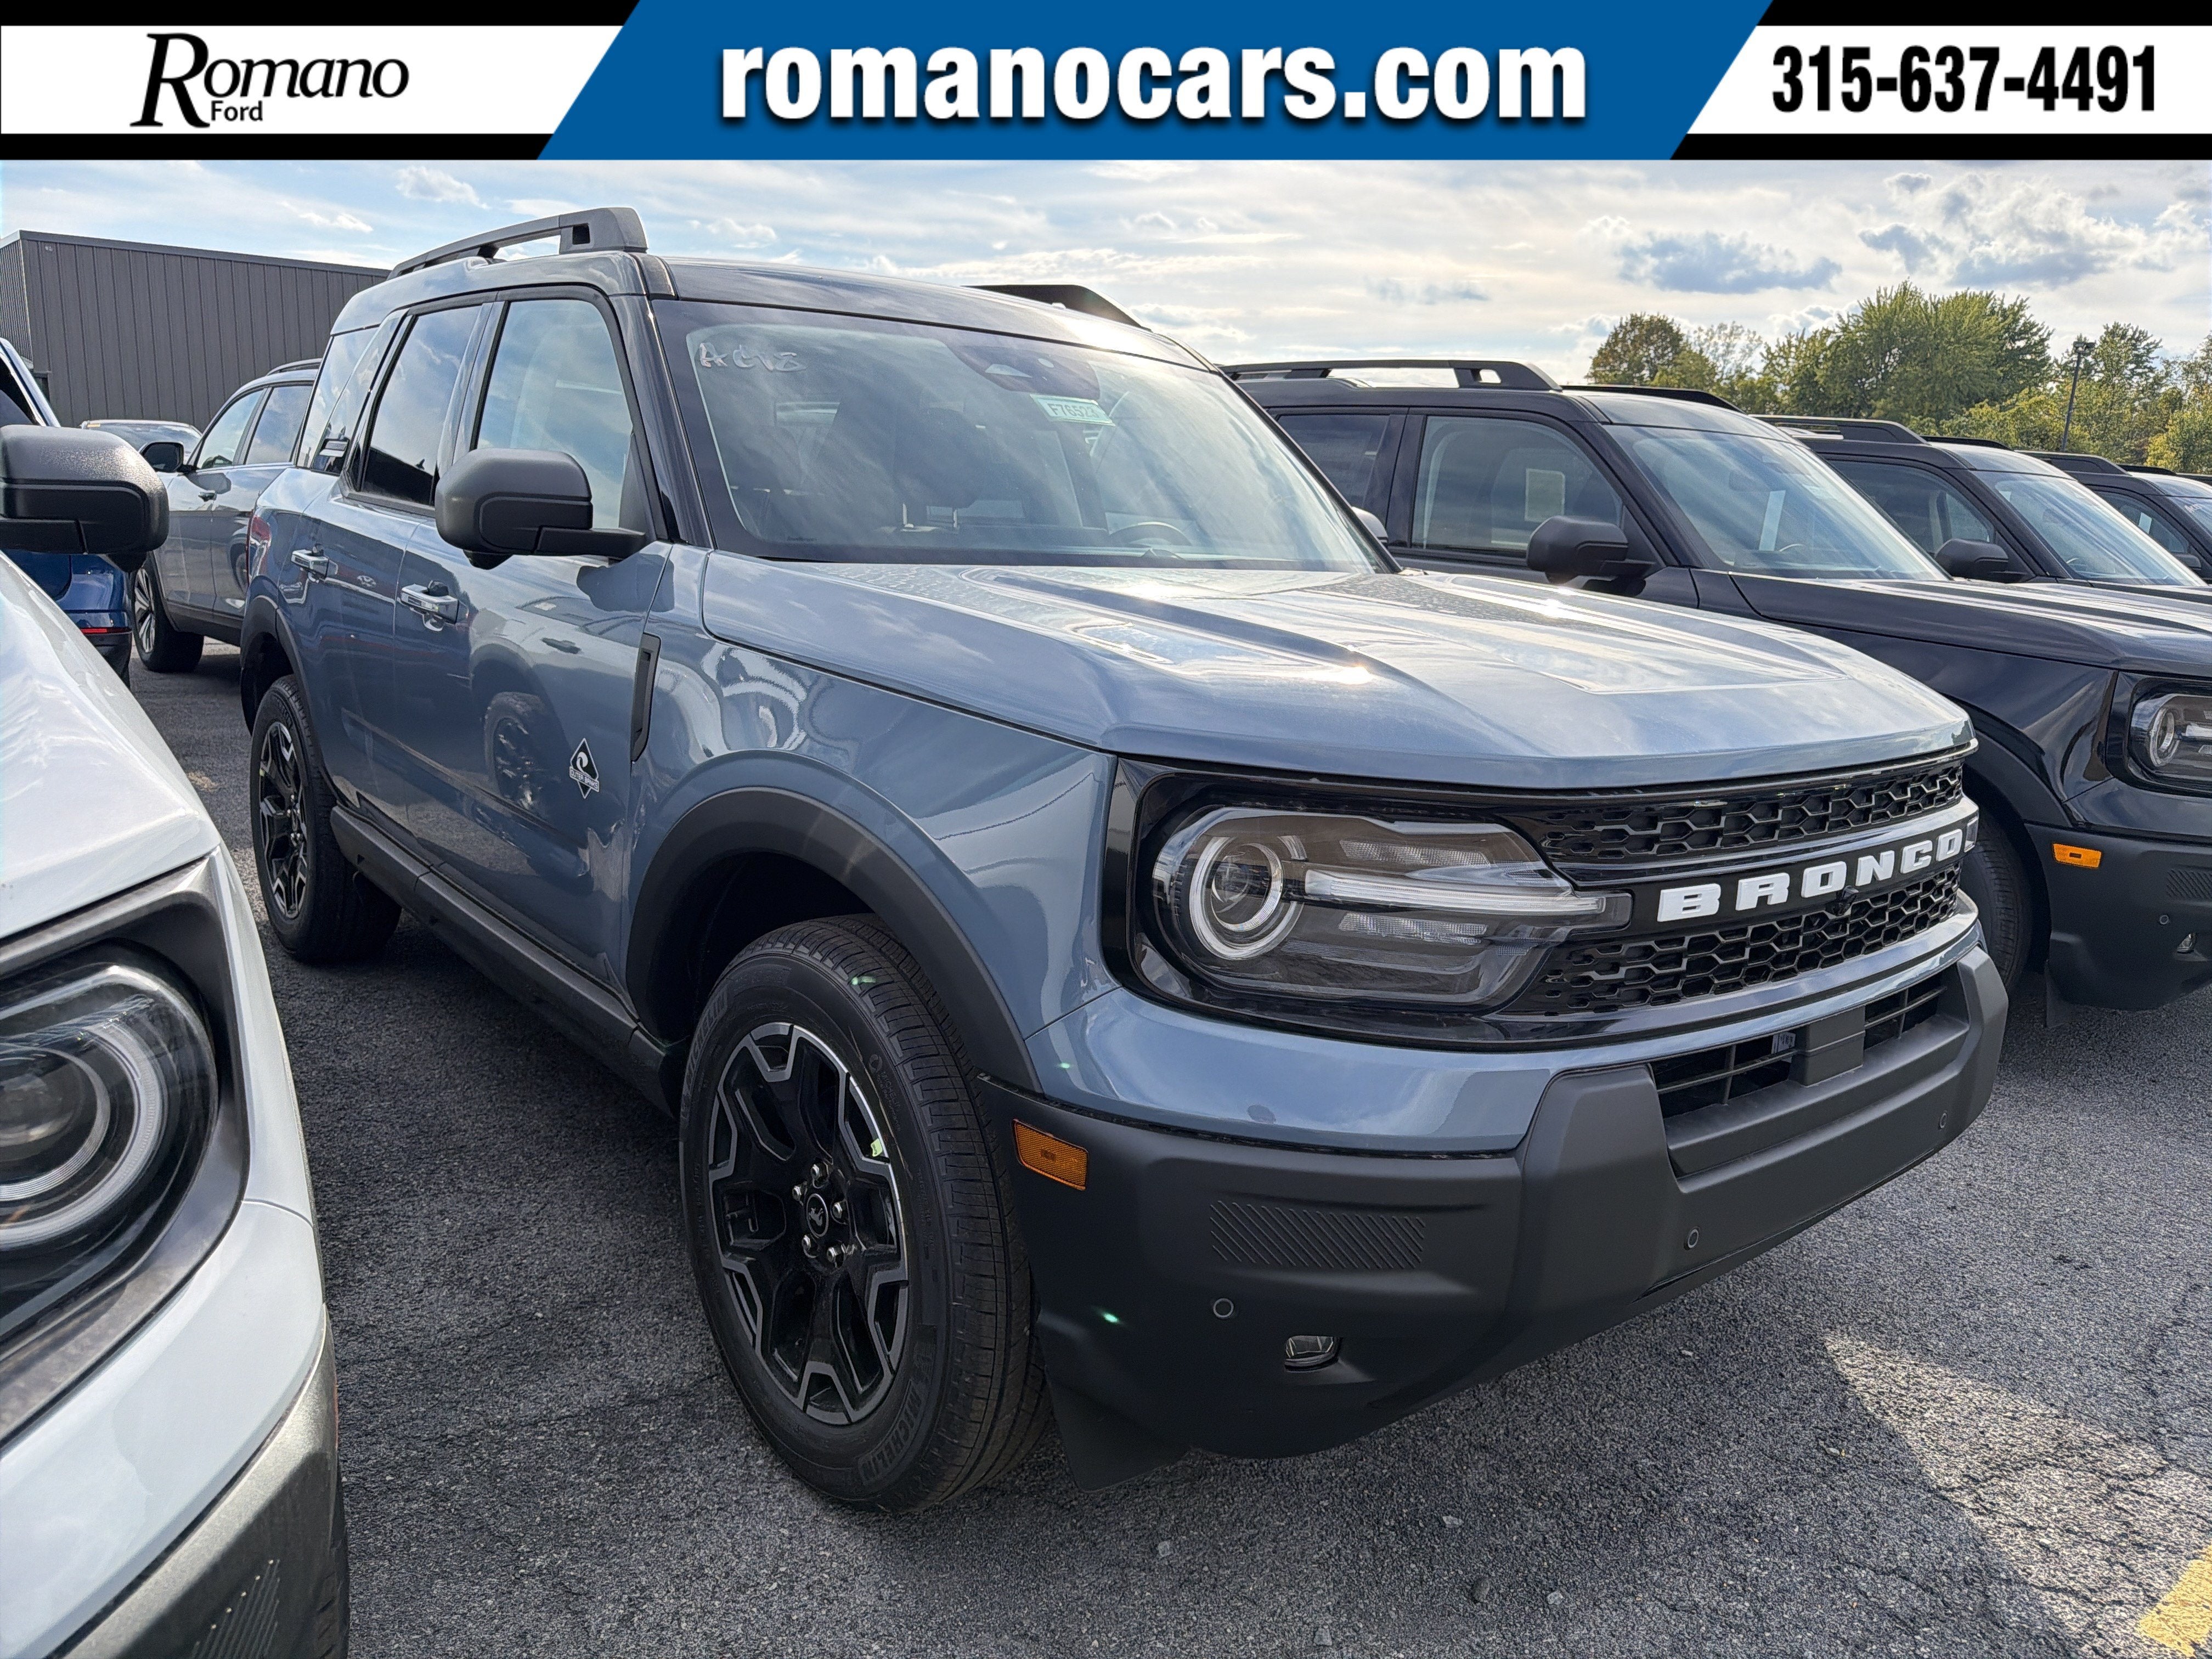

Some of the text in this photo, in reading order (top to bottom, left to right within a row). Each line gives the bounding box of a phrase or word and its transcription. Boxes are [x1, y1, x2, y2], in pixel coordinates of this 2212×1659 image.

[571, 769, 599, 789] OUTER BANKS
[1657, 828, 1962, 922] BRONCO
